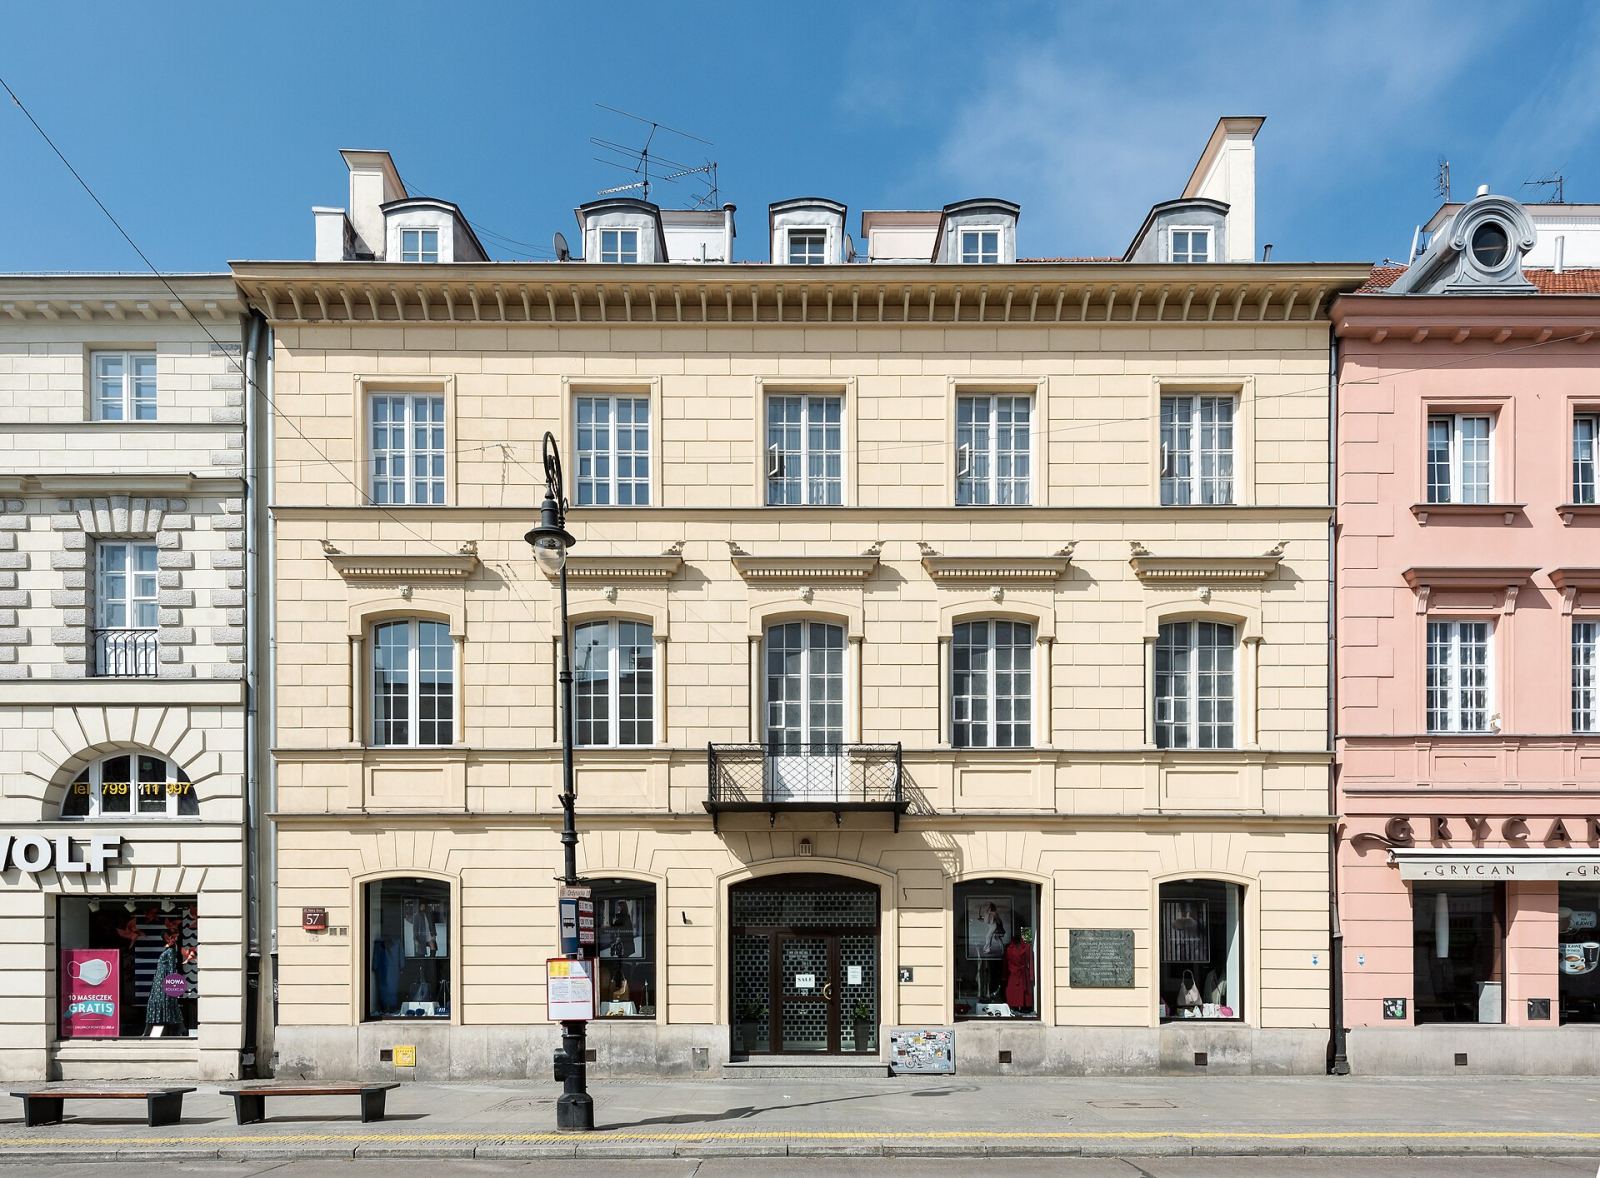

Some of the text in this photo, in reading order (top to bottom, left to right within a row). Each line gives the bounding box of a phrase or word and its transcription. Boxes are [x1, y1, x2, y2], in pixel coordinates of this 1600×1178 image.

[102, 782, 128, 795] 799
[138, 782, 159, 795] 111
[167, 782, 190, 795] 997
[0, 836, 121, 872] OLF
[1434, 865, 1515, 876] GRYCAN
[306, 913, 320, 925] 57
[69, 1003, 113, 1013] GRATIS
